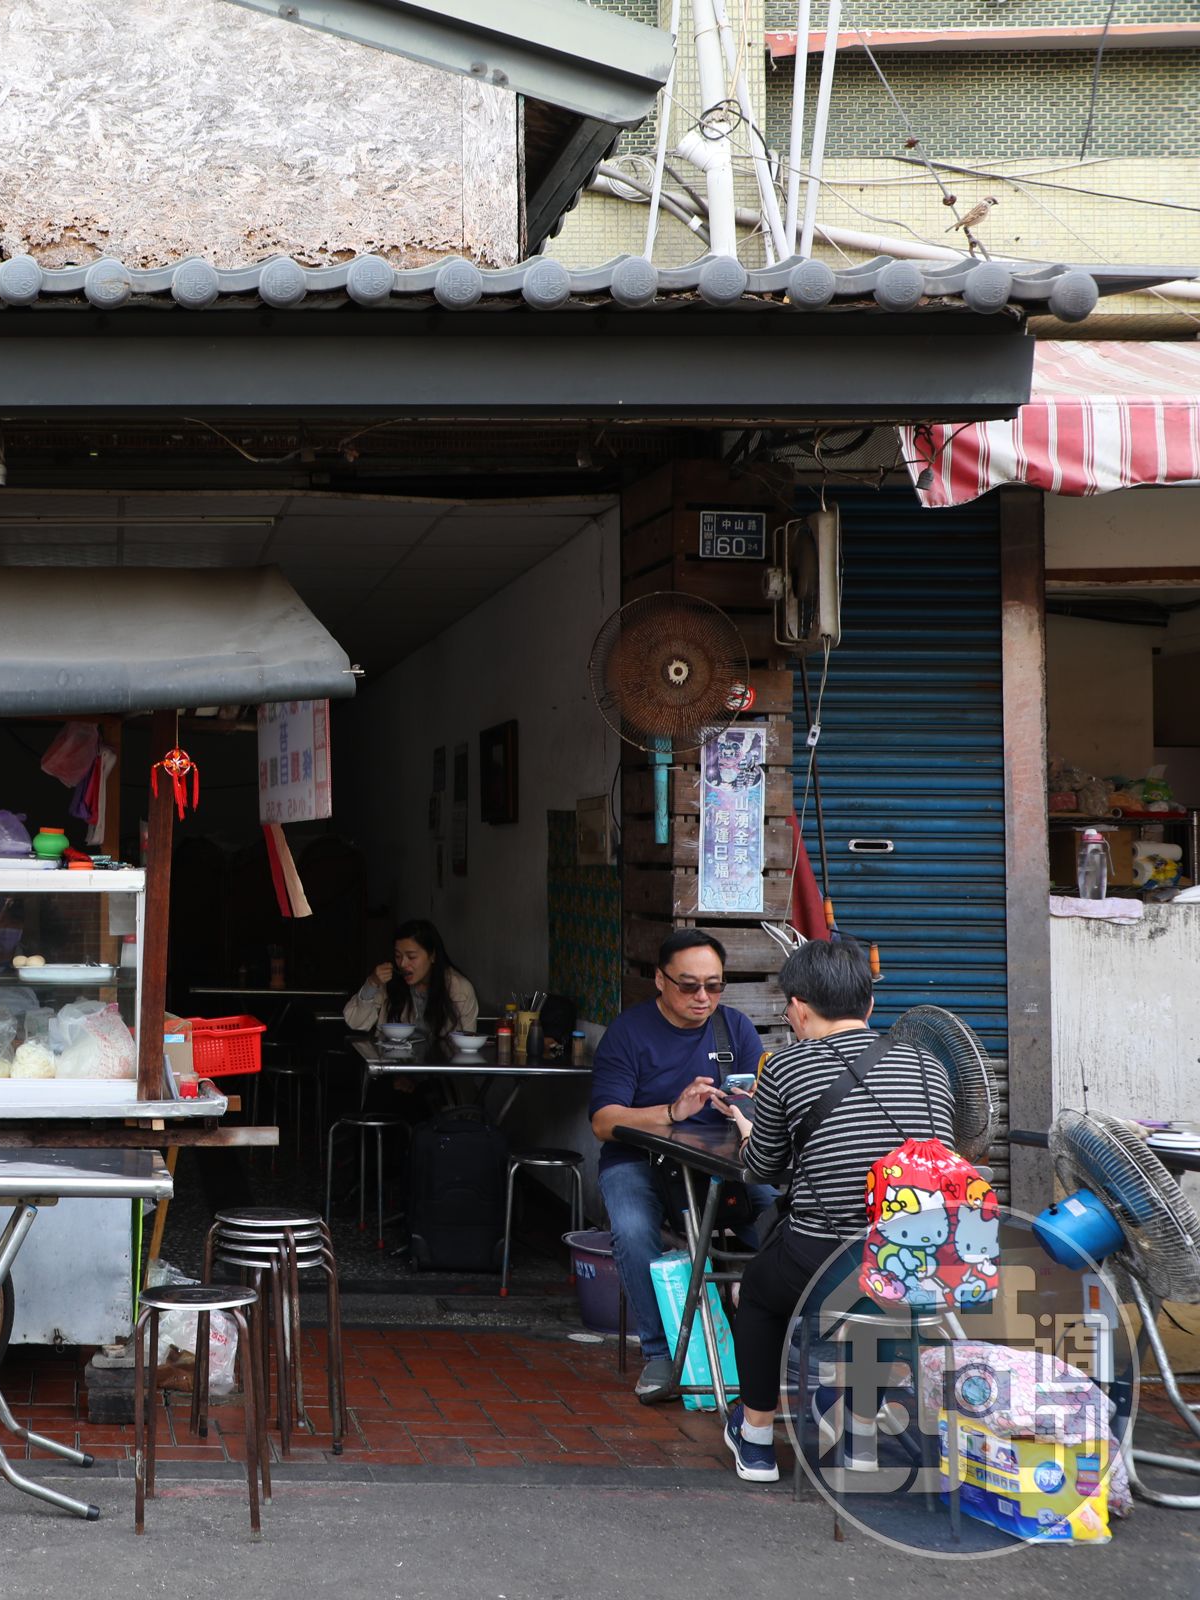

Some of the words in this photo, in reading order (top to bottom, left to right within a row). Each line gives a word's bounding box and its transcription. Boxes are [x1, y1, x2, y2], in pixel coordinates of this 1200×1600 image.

[722, 518, 757, 531] 中山路
[717, 537, 746, 556] 60
[733, 797, 750, 864] 山湧金泉
